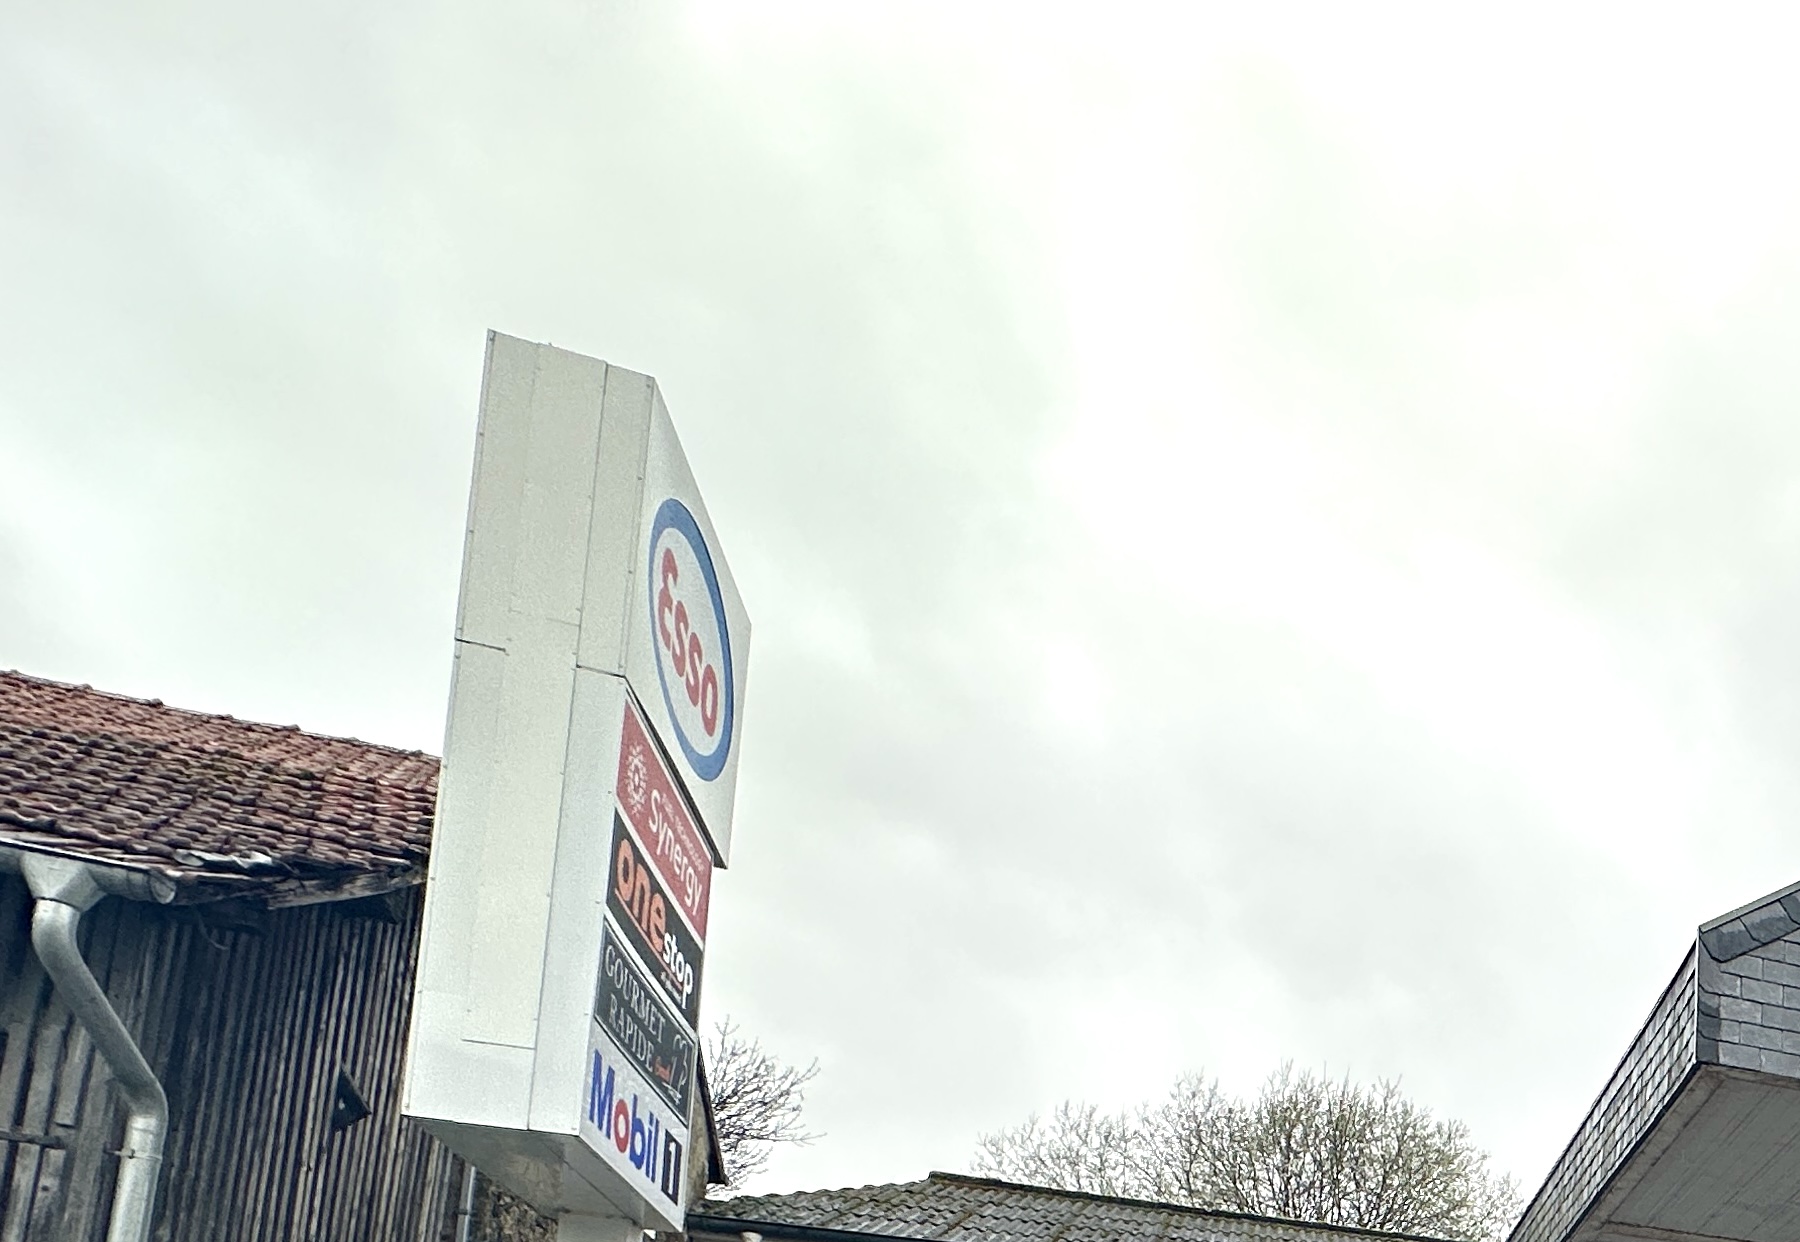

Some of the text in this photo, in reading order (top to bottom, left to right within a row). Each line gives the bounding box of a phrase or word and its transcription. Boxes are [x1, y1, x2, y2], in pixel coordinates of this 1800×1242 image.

[648, 788, 703, 917] Synergy
[616, 838, 667, 953] one
[662, 931, 694, 1010] stop
[604, 944, 667, 1044] GOURMET
[609, 992, 655, 1073] RAPIDE
[588, 1048, 660, 1183] Mobil
